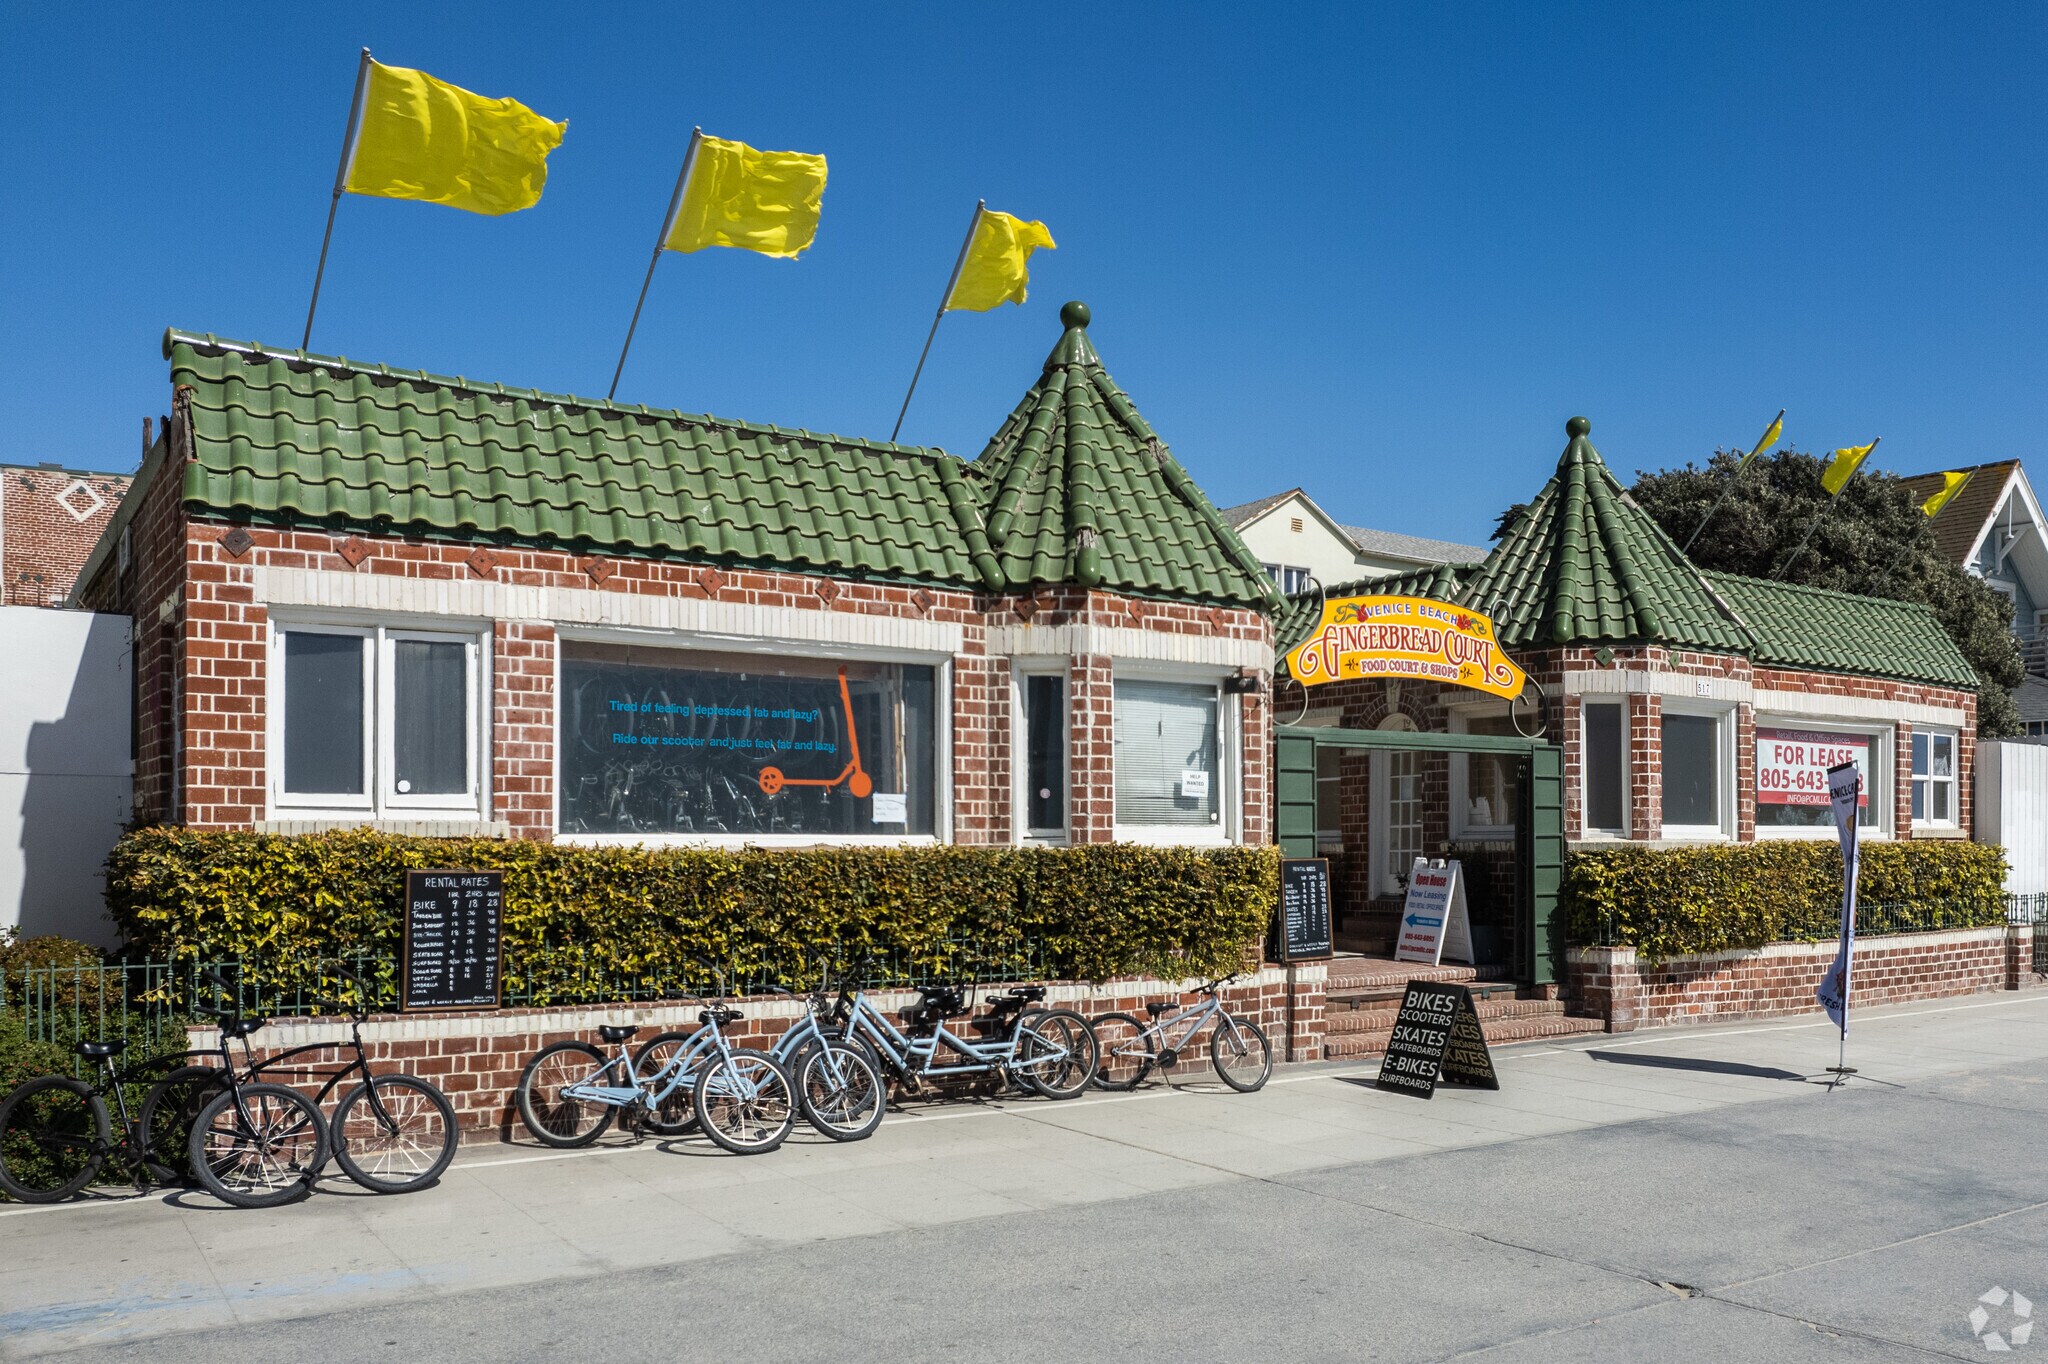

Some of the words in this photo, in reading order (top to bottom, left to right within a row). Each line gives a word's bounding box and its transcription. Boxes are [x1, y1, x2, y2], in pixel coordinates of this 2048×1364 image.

[1366, 603, 1411, 617] VENICE
[1420, 605, 1457, 624] BEACH
[1300, 625, 1442, 677] GINGERBREAD
[1444, 630, 1513, 687] COURT
[1361, 660, 1386, 673] FOOD
[1389, 660, 1419, 673] COURT
[1421, 662, 1428, 673] &
[1430, 662, 1458, 679] SHOPS
[609, 700, 637, 712] Tired
[640, 703, 651, 712] of
[654, 703, 690, 716] feeling
[694, 704, 751, 718] depressed,
[754, 707, 768, 718] fat
[772, 708, 790, 719] and
[791, 709, 818, 722] lazy?
[612, 733, 637, 744] Ride
[640, 736, 658, 745] our
[661, 736, 705, 746] scooter
[709, 737, 728, 747] and
[729, 737, 752, 750] just
[755, 738, 773, 749] feel
[777, 739, 791, 749] fat
[794, 740, 813, 750] and
[815, 740, 837, 753] lazy.
[1776, 730, 1793, 740] Retail,
[1794, 732, 1808, 741] Food
[1809, 734, 1814, 742] &
[1814, 734, 1830, 743] Office
[1830, 735, 1850, 745] Spaces
[1774, 745, 1804, 765] FOR
[1810, 747, 1853, 767] LEASE
[1760, 768, 1864, 792] 805-643-3
[1786, 794, 1832, 804] INFO@PCMLLC.
[425, 877, 459, 888] RENTAL
[461, 876, 490, 887] RATES
[1415, 873, 1429, 886] Open
[1429, 874, 1448, 887] House
[413, 901, 436, 910] BIKE
[452, 899, 458, 910] 9
[468, 899, 478, 908] 18
[487, 898, 498, 907] 28
[1410, 889, 1423, 898] Now
[1423, 890, 1447, 903] Leasing
[1406, 991, 1455, 1013] BIKES
[1399, 1009, 1452, 1026] SCOOTERS
[1393, 1025, 1446, 1047] SKATES
[1451, 1024, 1480, 1040] KES
[1390, 1041, 1441, 1057] SKATEBOARDS
[1450, 1040, 1484, 1052] EBOARDS
[1384, 1054, 1438, 1077] E-BIKES
[1444, 1048, 1489, 1067] KATES
[1380, 1072, 1432, 1090] SURFBOARDS
